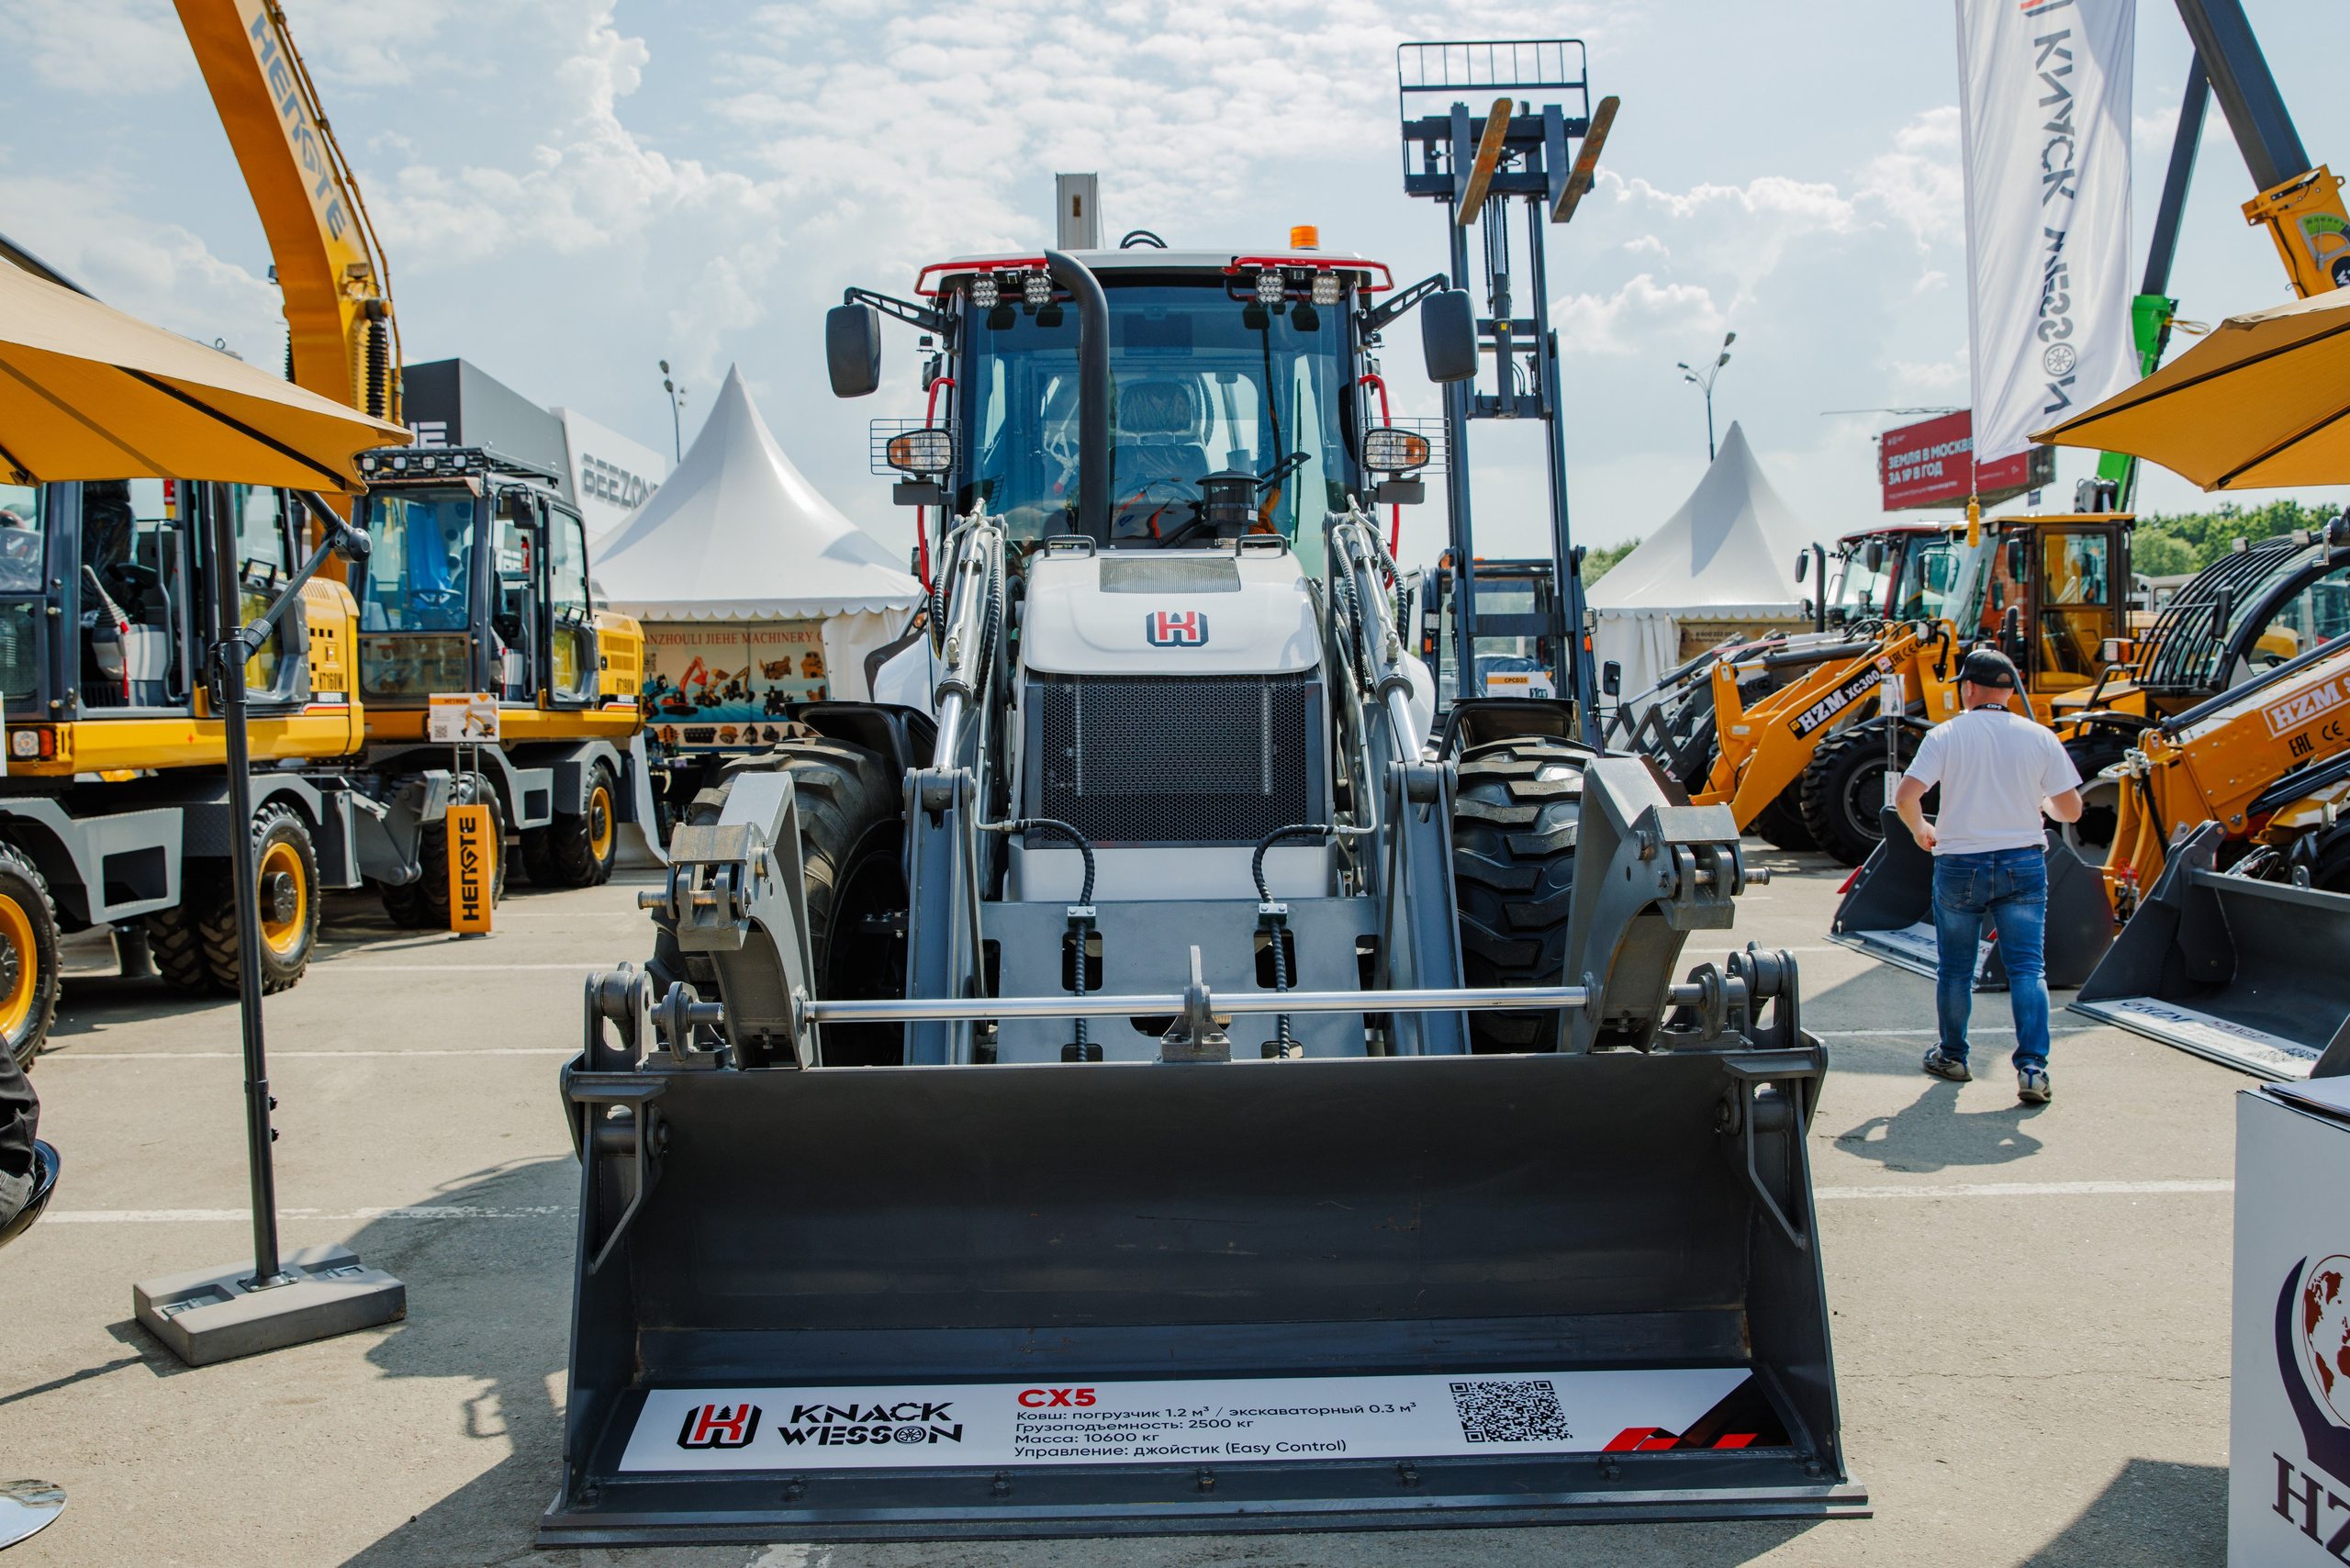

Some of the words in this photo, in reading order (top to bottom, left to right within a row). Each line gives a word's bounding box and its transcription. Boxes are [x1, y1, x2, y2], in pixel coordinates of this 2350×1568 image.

[250, 12, 347, 242] HENGTE
[1887, 449, 1921, 470] ЗЕМЛЯ
[1922, 447, 1930, 462] В
[1887, 469, 1902, 486] ЗА
[1913, 465, 1922, 480] В
[1922, 460, 1943, 478] ГОД
[706, 632, 738, 644] JIEHE
[742, 631, 814, 644] MACHINERY
[1796, 689, 1849, 733] HZM
[1845, 669, 1882, 700] XC300
[2270, 681, 2343, 730] HZM
[2322, 720, 2344, 741] CE
[459, 817, 480, 921] HENGTE
[1017, 1387, 1097, 1408] CX5
[789, 1402, 955, 1424] KNACK
[1016, 1411, 1068, 1421] Ковш:
[1072, 1410, 1160, 1421] погрузчик
[1165, 1408, 1187, 1418] 1.2
[1215, 1406, 1224, 1417] /
[1228, 1405, 1364, 1417] экскаваторный
[1369, 1404, 1395, 1414] 0.3
[777, 1424, 964, 1447] WESSON
[1015, 1420, 1184, 1434] Грузоподъемность:
[1188, 1418, 1232, 1429] 2500
[1237, 1420, 1254, 1428] кг
[1014, 1434, 1079, 1444] Масса:
[1084, 1432, 1137, 1443] 10600
[1142, 1433, 1160, 1442] кг
[1014, 1446, 1129, 1460] Управление:
[1134, 1444, 1220, 1457] джойстик
[1225, 1442, 1271, 1456] (Easy
[1275, 1439, 1348, 1453] Control)
